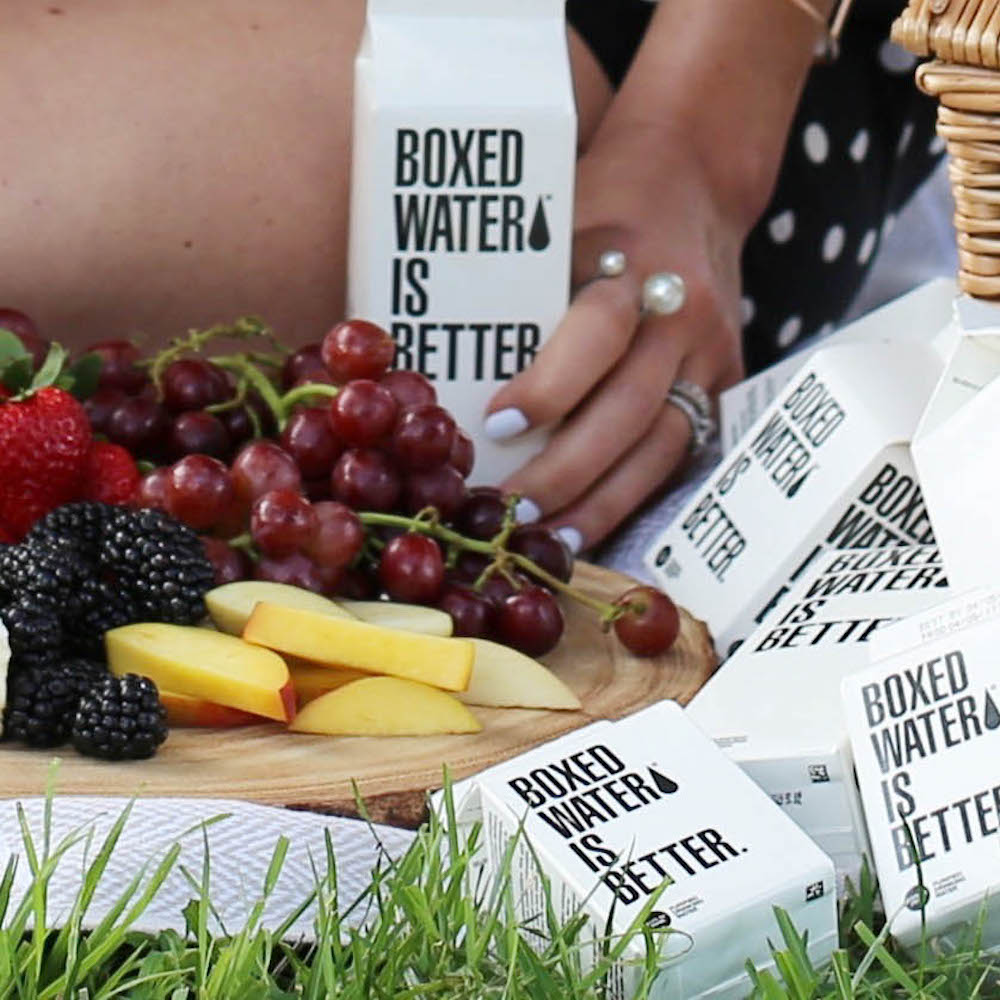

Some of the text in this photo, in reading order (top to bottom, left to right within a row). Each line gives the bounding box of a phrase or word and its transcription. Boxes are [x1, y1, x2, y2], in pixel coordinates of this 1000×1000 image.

[395, 128, 523, 187] BOXED
[394, 194, 524, 252] WATER
[391, 257, 430, 316] IS
[783, 372, 846, 448] BOXED
[715, 450, 751, 496] IS
[750, 411, 811, 493] WATER
[777, 599, 827, 626] IS
[803, 567, 942, 600] WATER
[752, 617, 905, 653] BETTE
[861, 650, 969, 729] BOXED
[870, 695, 983, 775] WATER
[507, 745, 626, 809] BOXED
[537, 773, 662, 840] WATER
[881, 771, 917, 824] IS
[569, 834, 620, 873] IS
[600, 828, 749, 906] BETTER.
